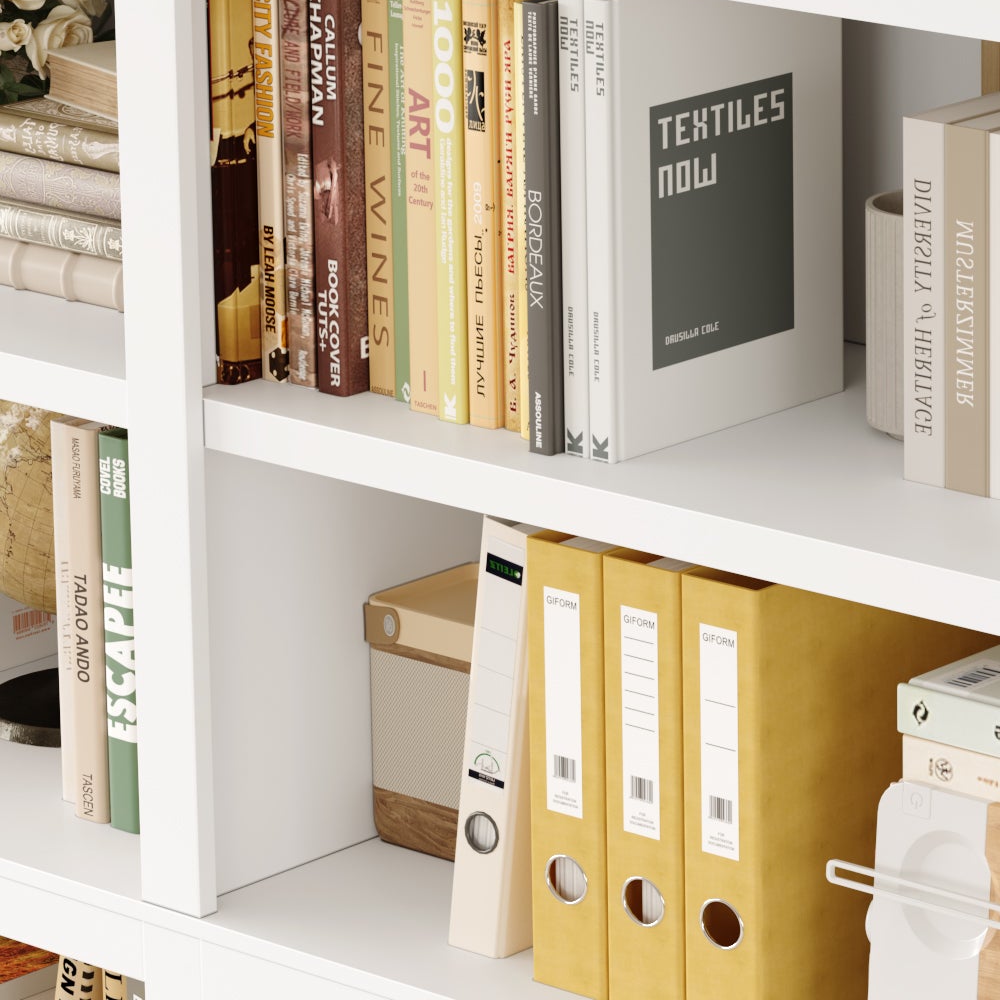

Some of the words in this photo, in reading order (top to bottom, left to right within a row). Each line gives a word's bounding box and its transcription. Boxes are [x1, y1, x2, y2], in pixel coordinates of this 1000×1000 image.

[283, 39, 301, 63] AND
[324, 14, 337, 100] CALLUM
[433, 1, 455, 134] 1000
[570, 18, 580, 93] TEXTILES
[595, 22, 605, 97] TEXTILES
[254, 42, 274, 138] FASHION
[366, 31, 385, 148] FINE
[408, 88, 431, 159] ART
[657, 88, 785, 150] TEXTILES
[286, 173, 296, 194] Chris
[298, 153, 310, 177] Edited
[411, 170, 418, 178] of
[420, 171, 430, 181] the
[658, 152, 717, 199] NOW
[286, 196, 296, 216] Speed
[408, 196, 434, 210] Century
[413, 183, 428, 194] 20th
[473, 181, 483, 225] 2009
[263, 224, 274, 244] BY
[288, 219, 296, 232] and
[264, 245, 274, 282] LEAH
[288, 235, 297, 265] Victoria
[370, 176, 389, 346] WINES
[474, 235, 483, 304] ПЬЕСЫ
[528, 189, 544, 309] BORDEAUX
[288, 268, 298, 288] Clare
[300, 278, 311, 306] Michael
[327, 259, 338, 320] BOOK
[264, 284, 276, 334] MOOSE
[318, 290, 330, 352] TUTS+
[328, 322, 341, 388] COVER
[665, 326, 700, 346] DRUSILLA
[701, 320, 720, 335] COLE
[475, 314, 485, 398] ЛУЧШИЕ
[534, 391, 543, 449] ASSOULINE
[71, 438, 80, 462] MASAO
[72, 462, 82, 499] FURUYAMA
[100, 456, 112, 495] COVEL
[113, 458, 127, 499] BOOKS
[74, 574, 89, 631] TADAO
[546, 595, 577, 610] GIFORM
[623, 614, 655, 630] GIFORM
[76, 634, 90, 683] ANDO
[702, 632, 735, 648] GIFORM
[82, 773, 94, 817] TASCEN
